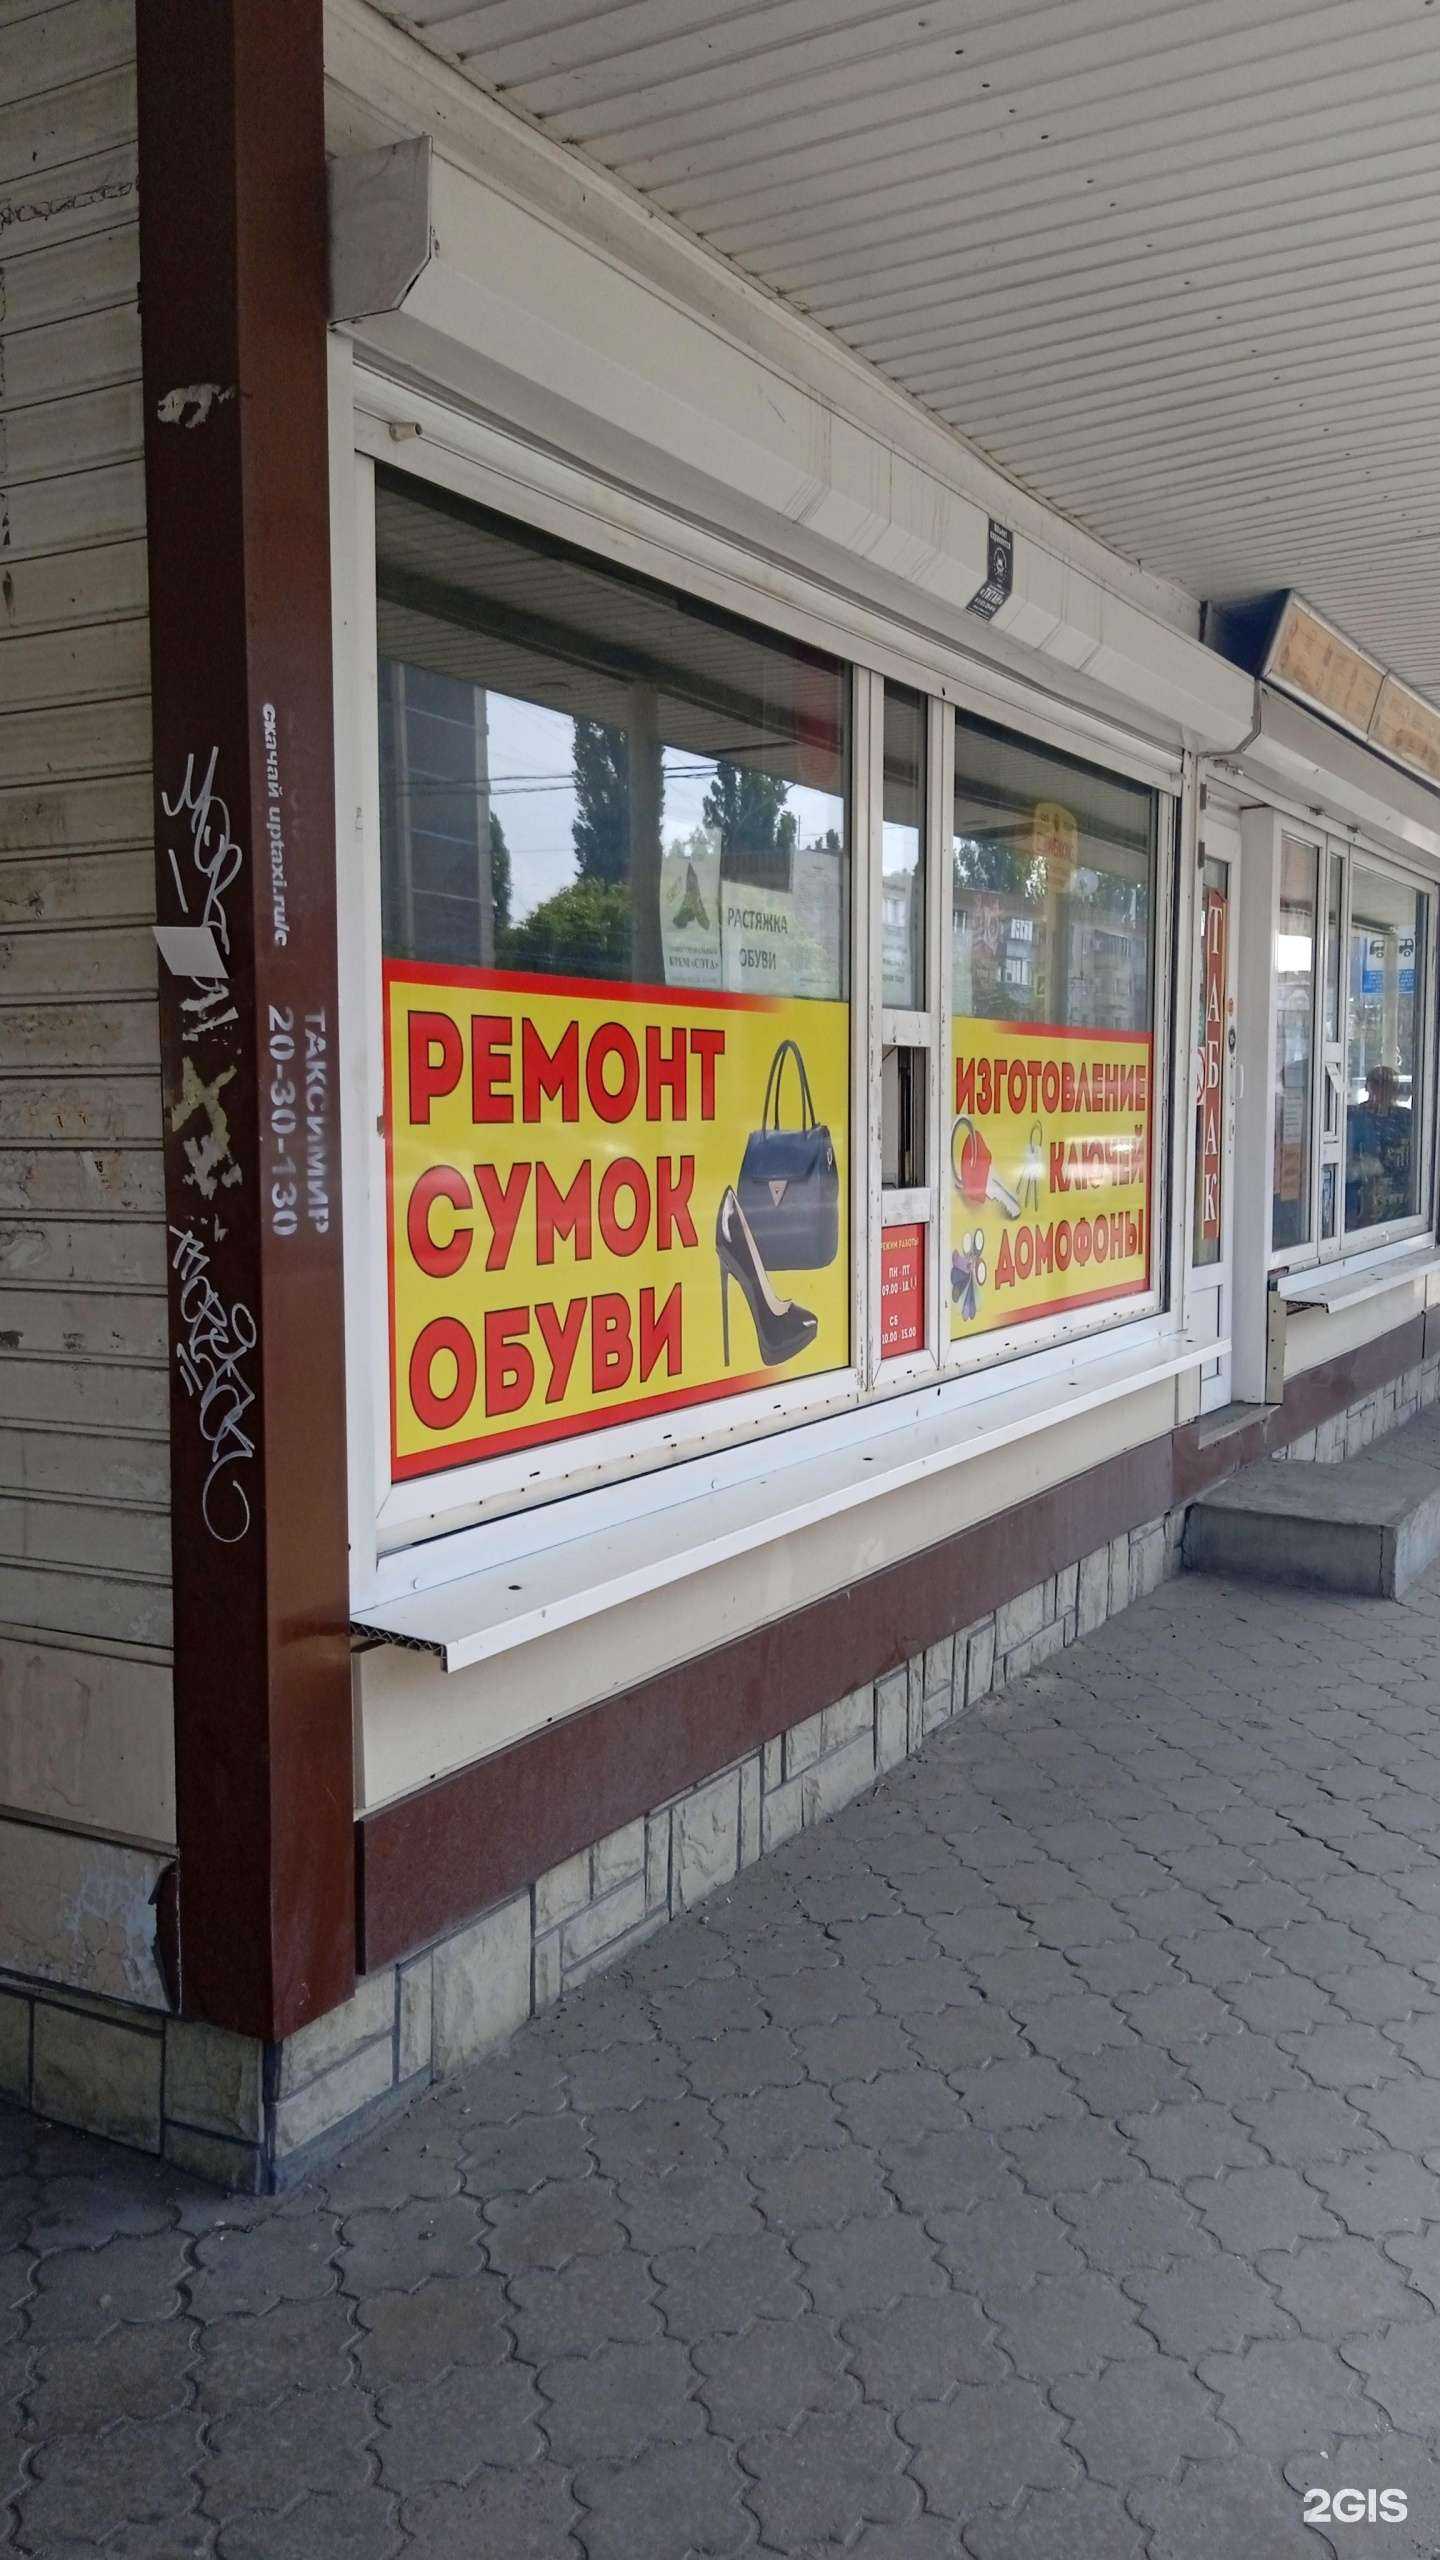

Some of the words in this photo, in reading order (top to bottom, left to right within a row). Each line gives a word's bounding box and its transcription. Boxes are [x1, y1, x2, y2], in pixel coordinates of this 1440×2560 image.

[262, 703, 284, 798] скачай
[728, 908, 789, 934] РАСТЯЖКА
[739, 948, 777, 970] ОБУВИ
[407, 1009, 726, 1125] РЕМОНТ
[955, 1057, 1147, 1115] ИЗГОТОВЛЕНИЕ
[1204, 906, 1223, 1222] ТАБАК
[268, 1004, 298, 1236] 20-30-130
[305, 1006, 329, 1234] ТАКСИМИР
[1050, 1124, 1145, 1193] КЛЮЧЕЙ
[407, 1155, 699, 1278] СУМОК
[994, 1209, 1144, 1290] ДОМОФОНЫ
[889, 1266, 898, 1278] ПН
[902, 1264, 910, 1276] ПТ
[409, 1282, 683, 1431] ОБУВИ
